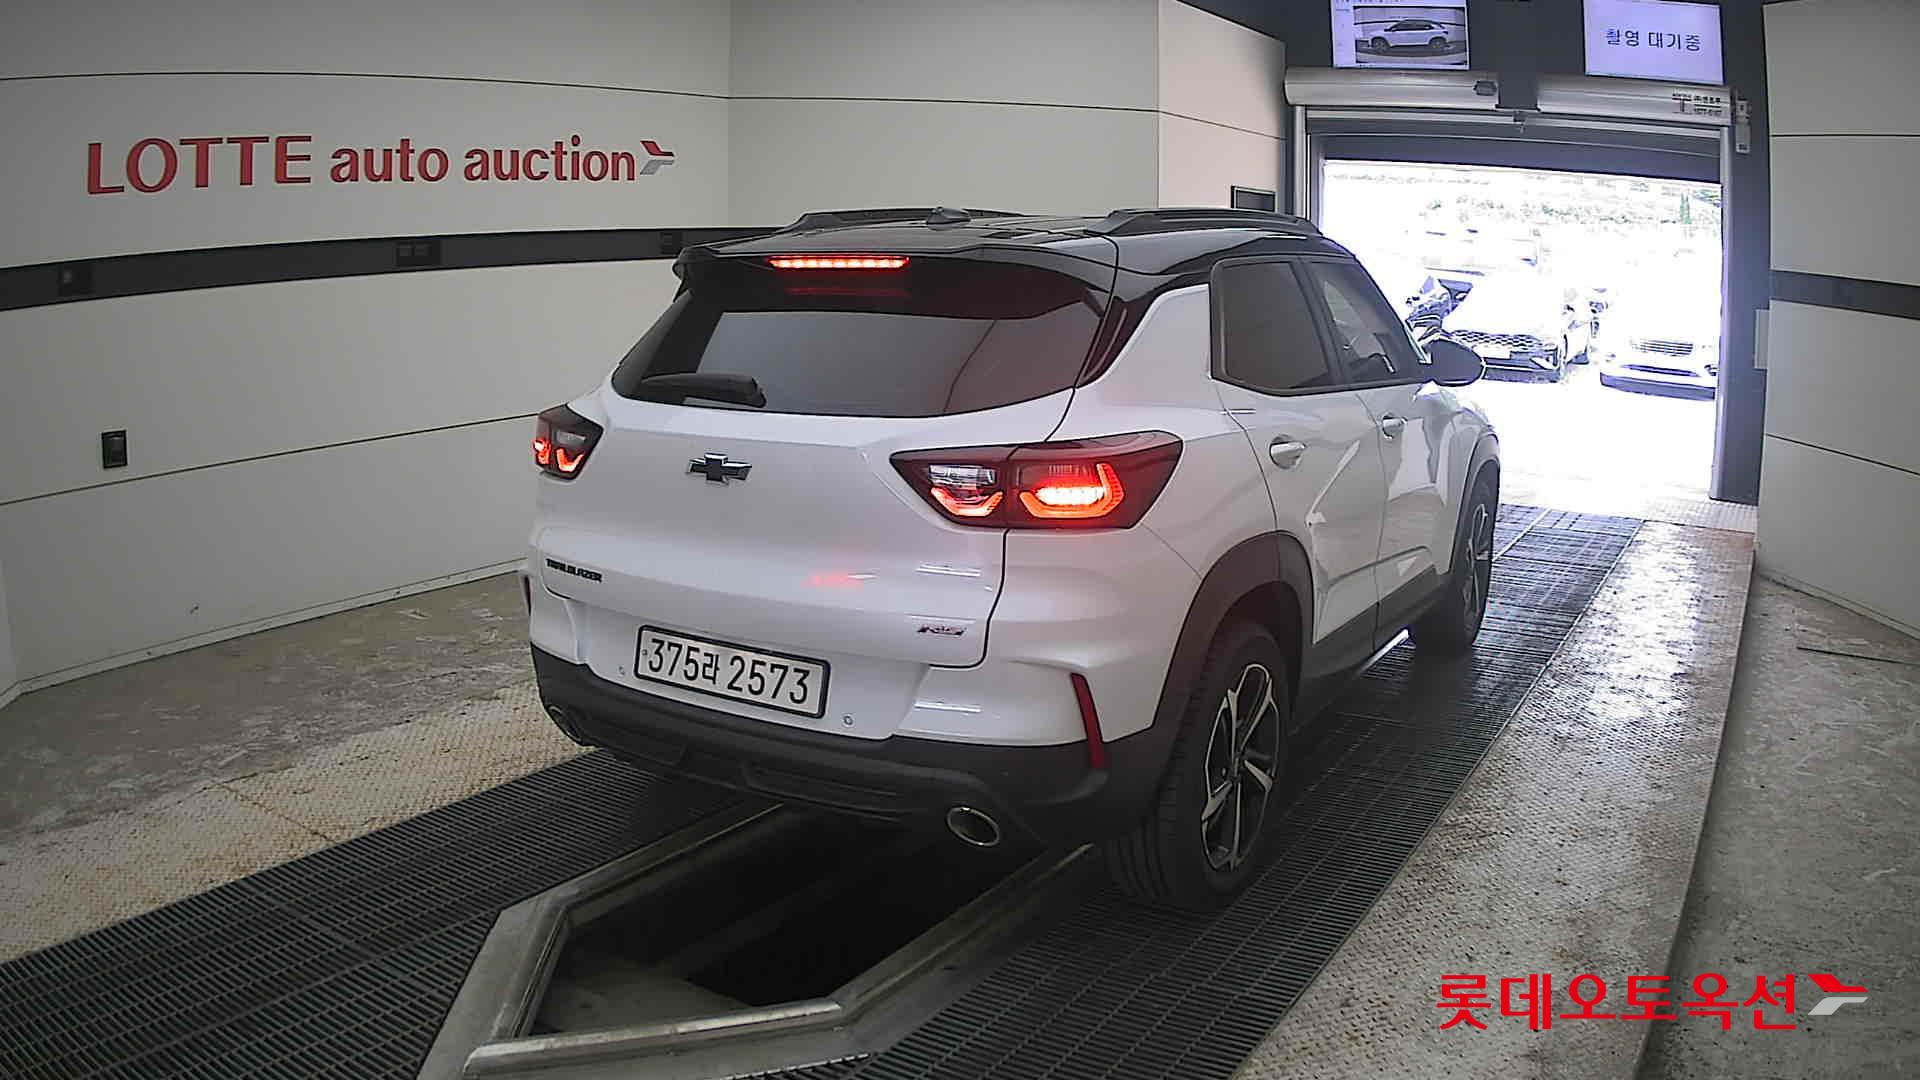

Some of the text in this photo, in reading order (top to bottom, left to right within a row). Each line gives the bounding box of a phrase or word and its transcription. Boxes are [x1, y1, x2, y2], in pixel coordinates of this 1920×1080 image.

[1606, 28, 1701, 52] 촬영 대기중
[87, 135, 636, 194] LOTTE auto auction
[648, 638, 811, 704] 375라 2573
